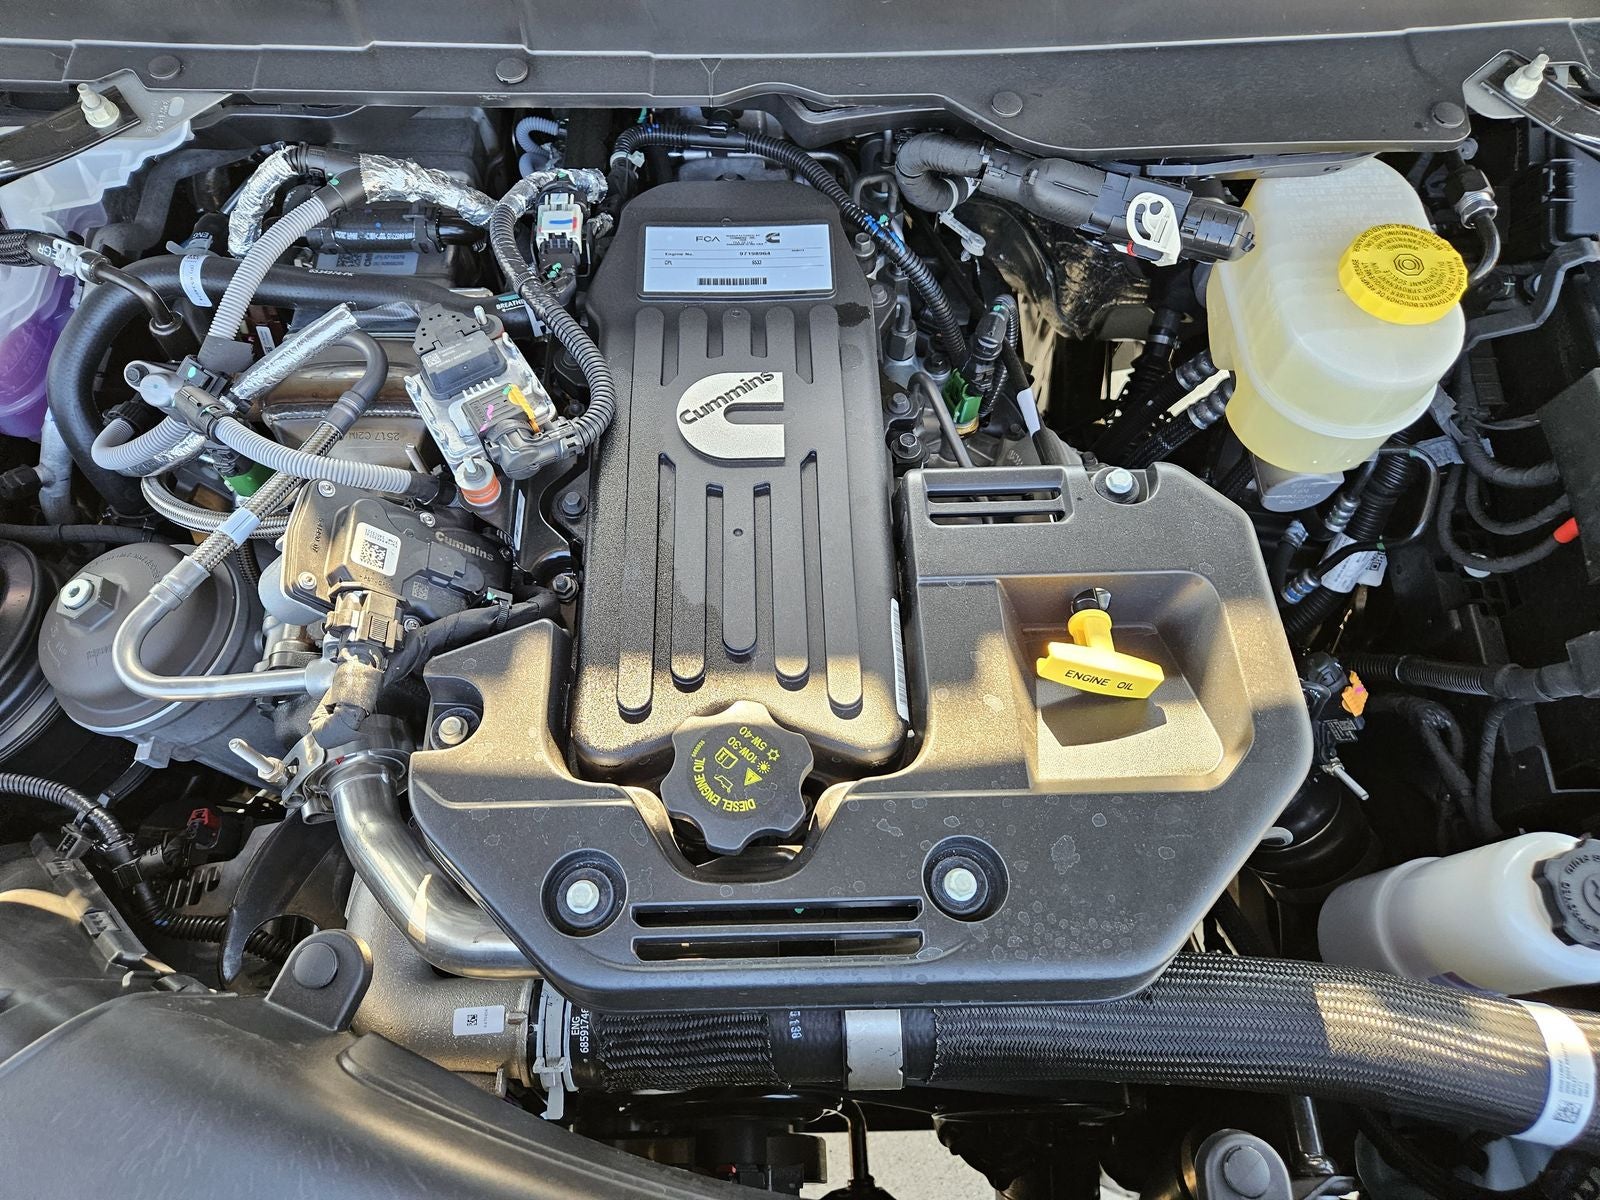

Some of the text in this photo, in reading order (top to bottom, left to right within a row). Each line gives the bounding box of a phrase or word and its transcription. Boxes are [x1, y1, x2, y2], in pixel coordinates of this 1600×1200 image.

[695, 235, 721, 243] FCA
[679, 370, 776, 426] Cummins
[434, 531, 495, 562] Cummins
[1064, 669, 1134, 691] ENGINE OIL
[727, 736, 759, 764] 10W-30
[739, 726, 768, 751] 5W-40
[692, 757, 757, 812] DIESEL ENGINE OIL
[571, 1016, 581, 1036] ENG
